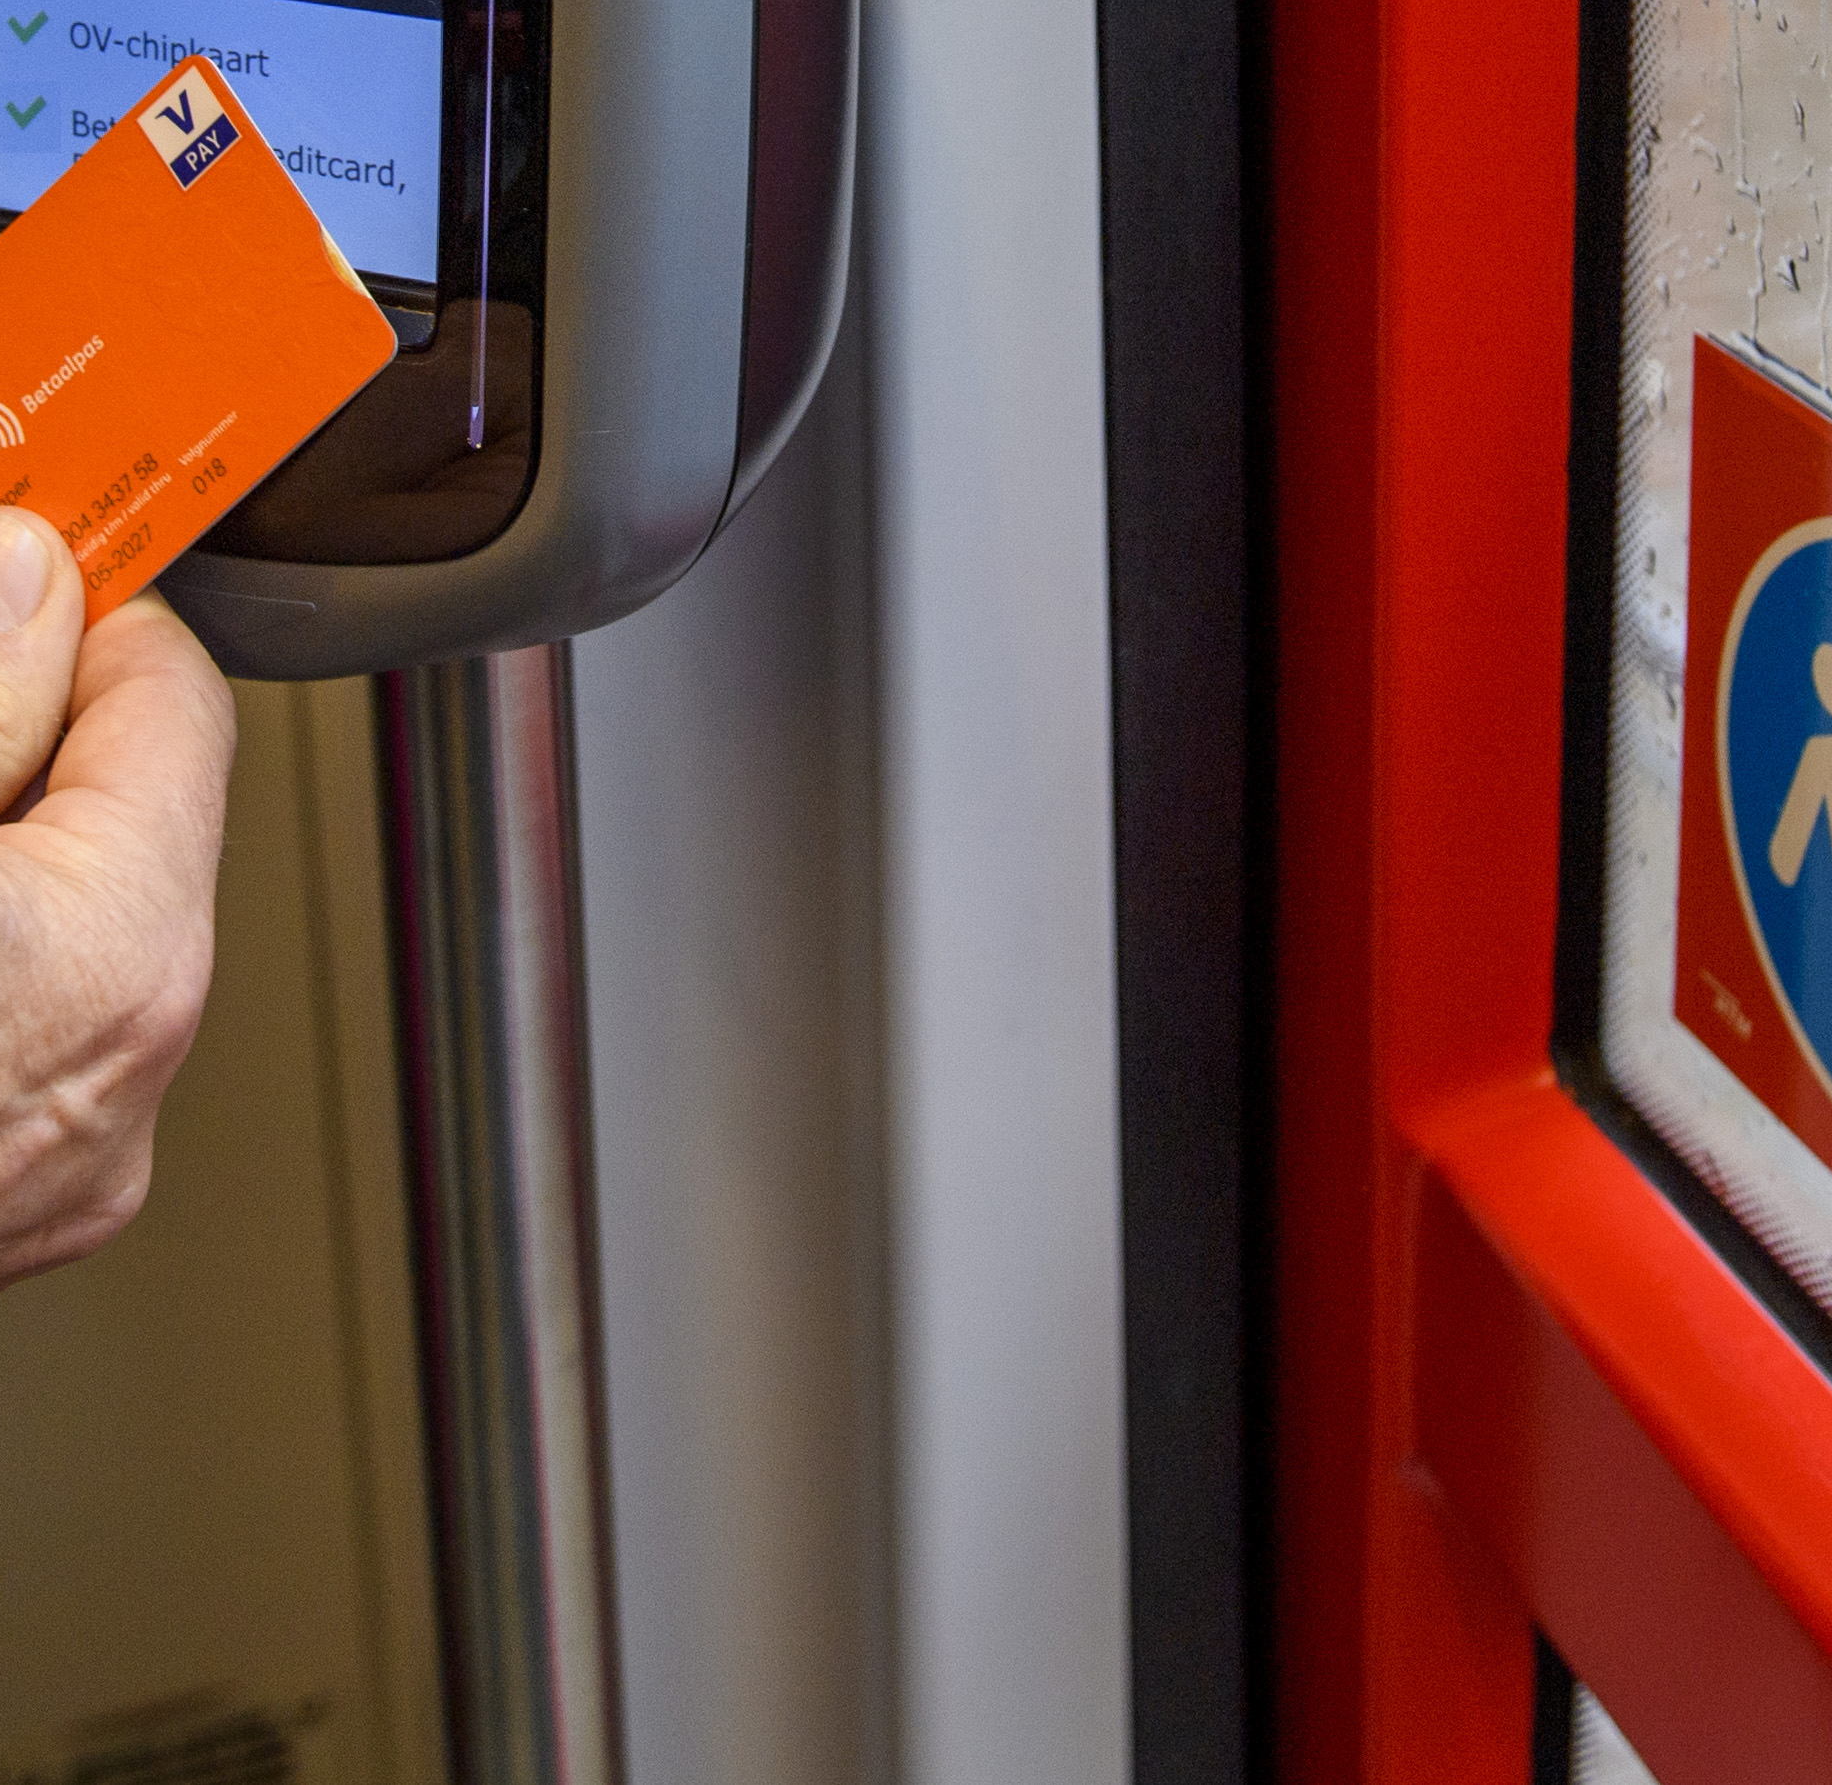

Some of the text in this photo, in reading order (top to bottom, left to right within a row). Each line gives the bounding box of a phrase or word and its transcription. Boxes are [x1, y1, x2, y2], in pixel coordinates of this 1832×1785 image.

[70, 22, 270, 77] OV-chipkaart
[155, 89, 196, 136] V
[184, 130, 222, 172] PAY
[21, 334, 106, 415] Betaalpas
[91, 473, 132, 519] 3437
[133, 453, 159, 481] 58
[192, 457, 227, 495] 018
[87, 522, 153, 591] 05-2027
